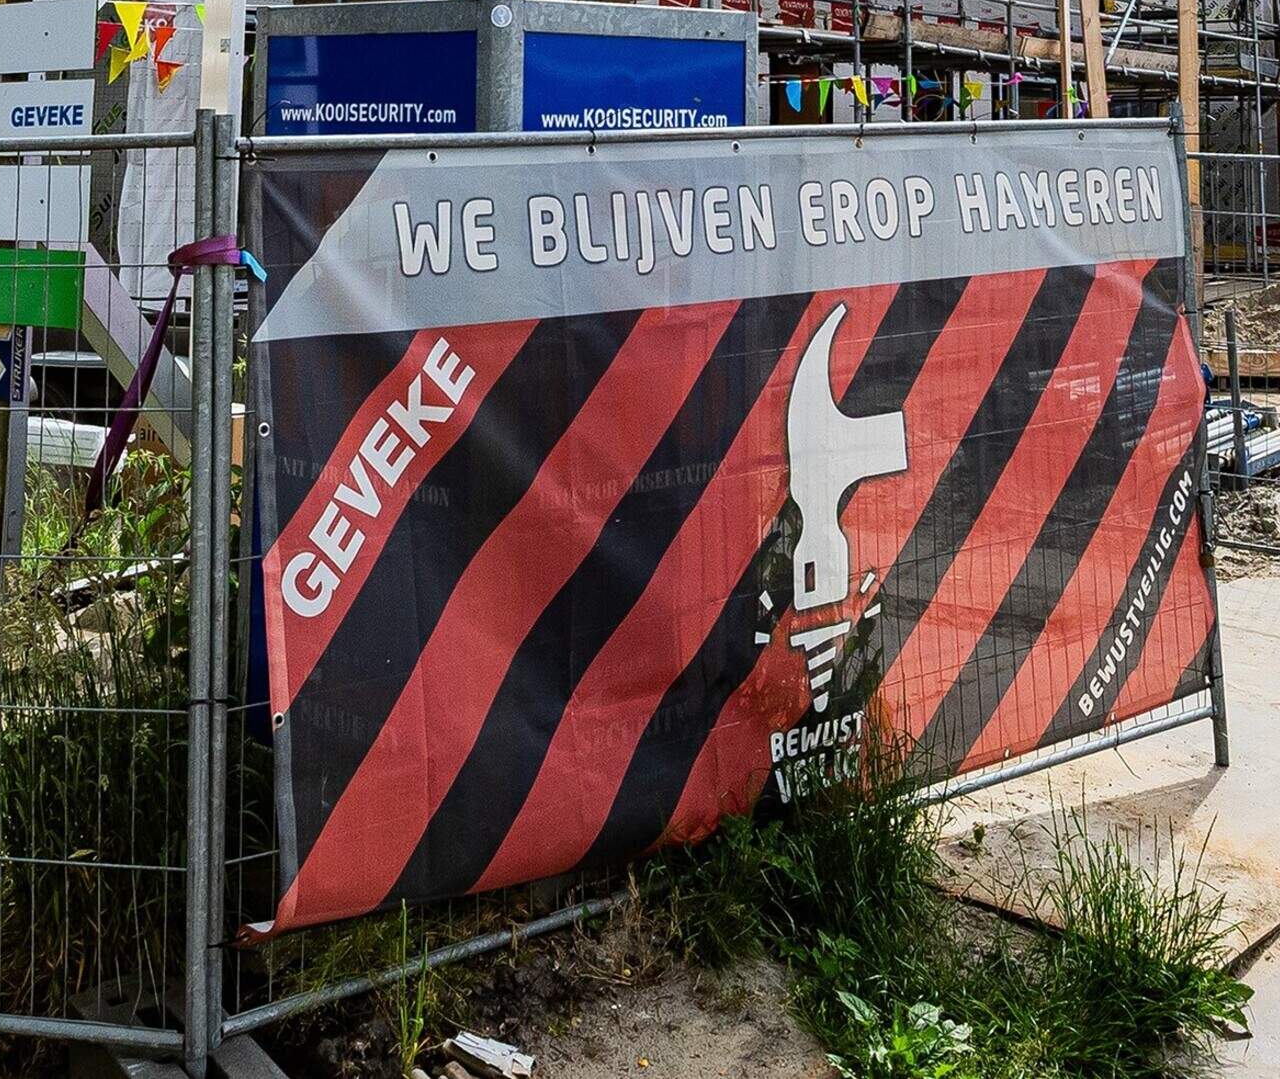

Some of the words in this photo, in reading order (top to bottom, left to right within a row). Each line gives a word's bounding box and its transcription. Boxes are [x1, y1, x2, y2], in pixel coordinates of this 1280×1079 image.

[11, 104, 84, 128] GEVEKE
[281, 103, 456, 123] www.KOOISECURITY.com
[542, 108, 728, 130] www.KOOISECURITY.com
[394, 197, 499, 276] WE
[528, 184, 777, 275] BLIJVEN
[797, 176, 936, 245] EROP
[955, 166, 1164, 233] HAMEREN
[281, 337, 476, 618] GEVEKE
[1078, 470, 1192, 717] BEWUSTVEILIG.COM
[770, 710, 865, 763] BEWUST
